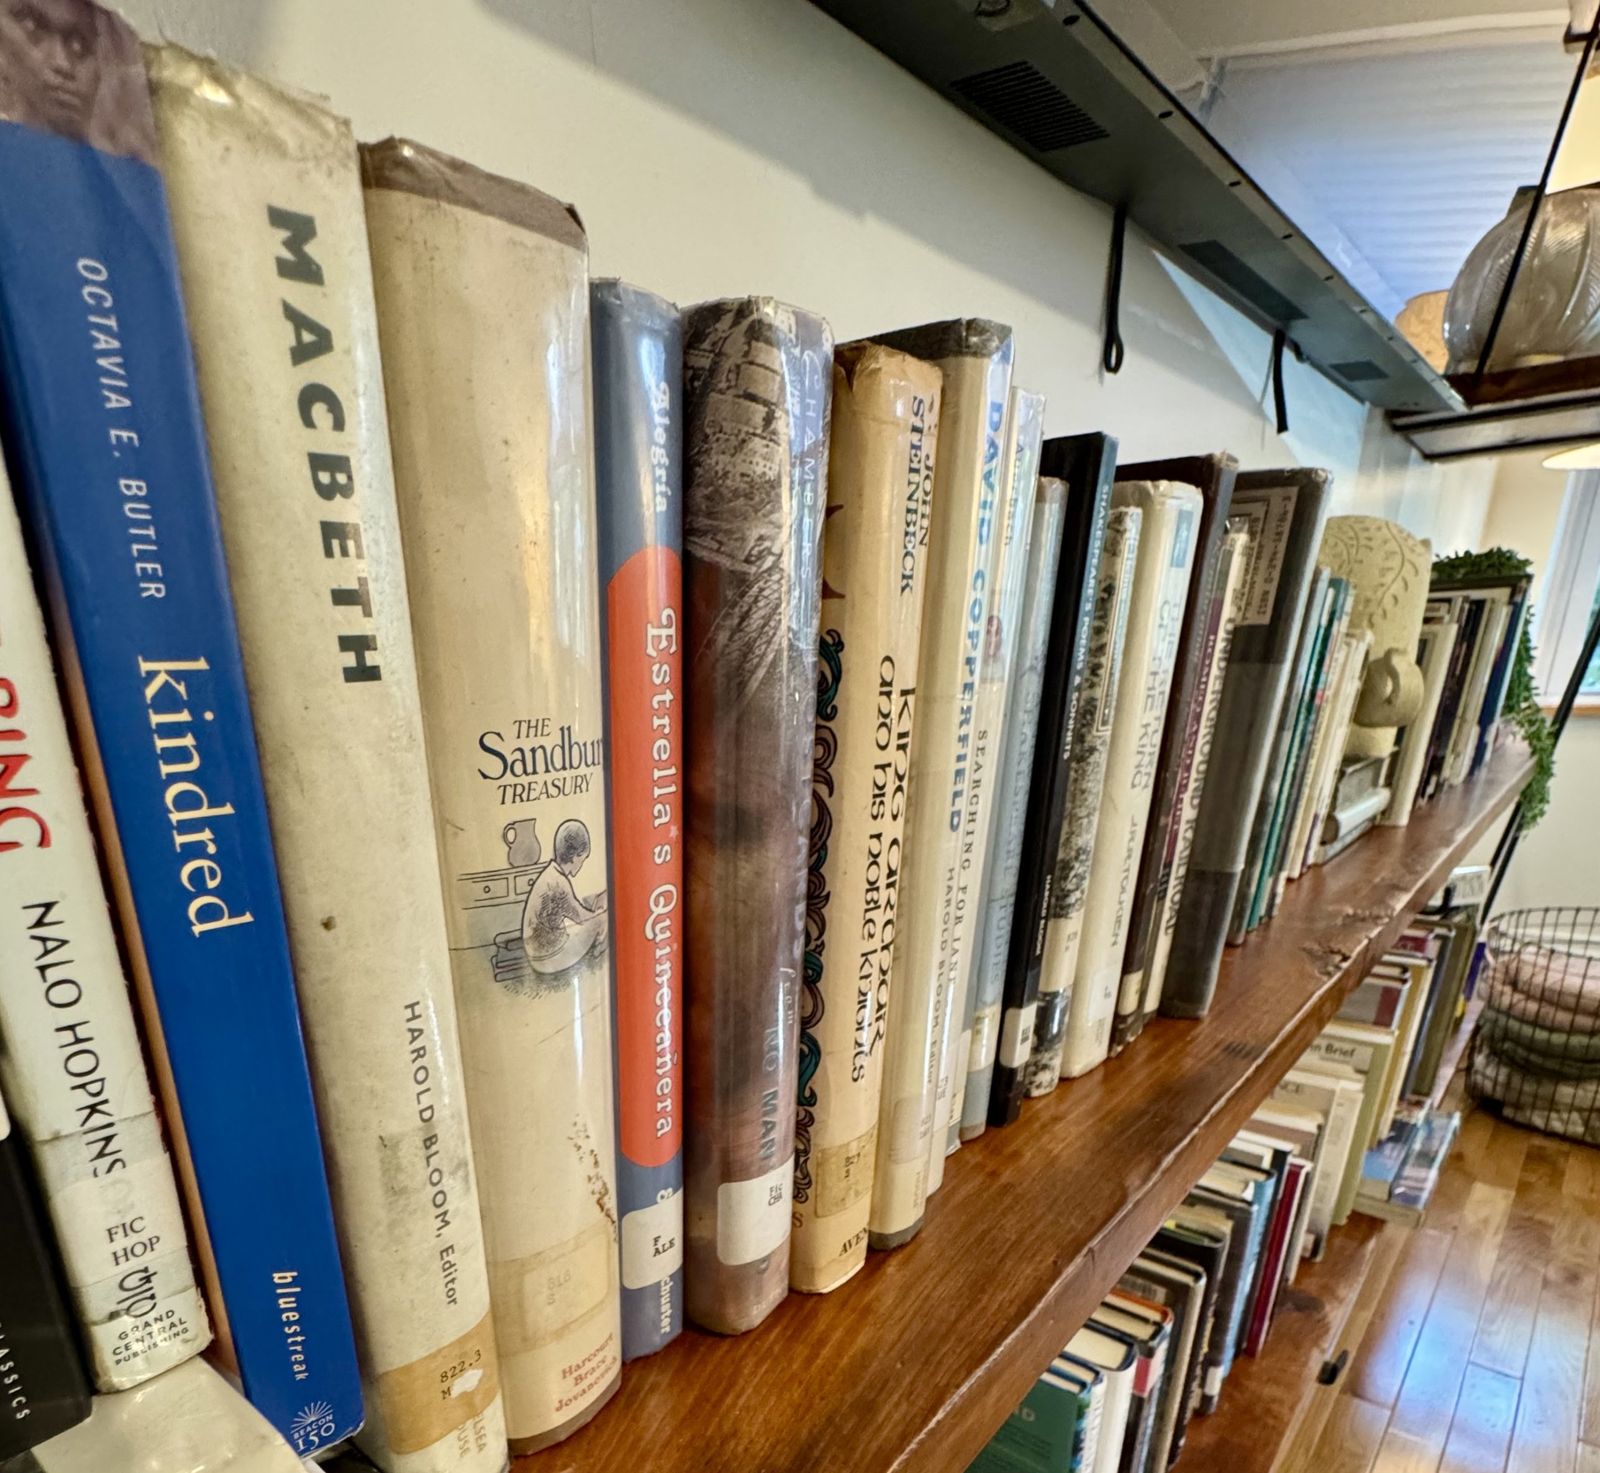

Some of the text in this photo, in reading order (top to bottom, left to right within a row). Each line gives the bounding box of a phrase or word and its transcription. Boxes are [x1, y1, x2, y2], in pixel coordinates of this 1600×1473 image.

[76, 257, 166, 600] OCTAVIA E. BUTLER
[266, 204, 382, 684] MACBETH
[801, 349, 823, 579] CHAMBERS
[899, 395, 925, 598] STEINBECK
[918, 453, 935, 548] JOHN
[948, 401, 1004, 833] DAVID COPPERFIELD
[513, 717, 552, 739] THE
[138, 656, 254, 937] kindred
[497, 772, 594, 806] TREASURY
[961, 729, 988, 871] SEARCHING
[938, 867, 955, 952] HAROLD
[954, 885, 968, 926] FOR
[22, 901, 126, 1178] NALO HOPKINS
[404, 1001, 459, 1306] HAROLD BLOOM, Editor
[106, 1216, 146, 1243] FIC
[112, 1235, 161, 1266] HOP
[652, 1237, 676, 1258] ALE
[653, 1235, 661, 1247] F
[118, 1309, 176, 1341] GRAND
[272, 1271, 310, 1381] bluestreak
[660, 1276, 674, 1334] chuster
[112, 1317, 188, 1357] CENTRAL
[115, 1326, 190, 1366] PUBLISHING
[440, 1349, 482, 1383] 822.3
[293, 1414, 334, 1440] BEACON
